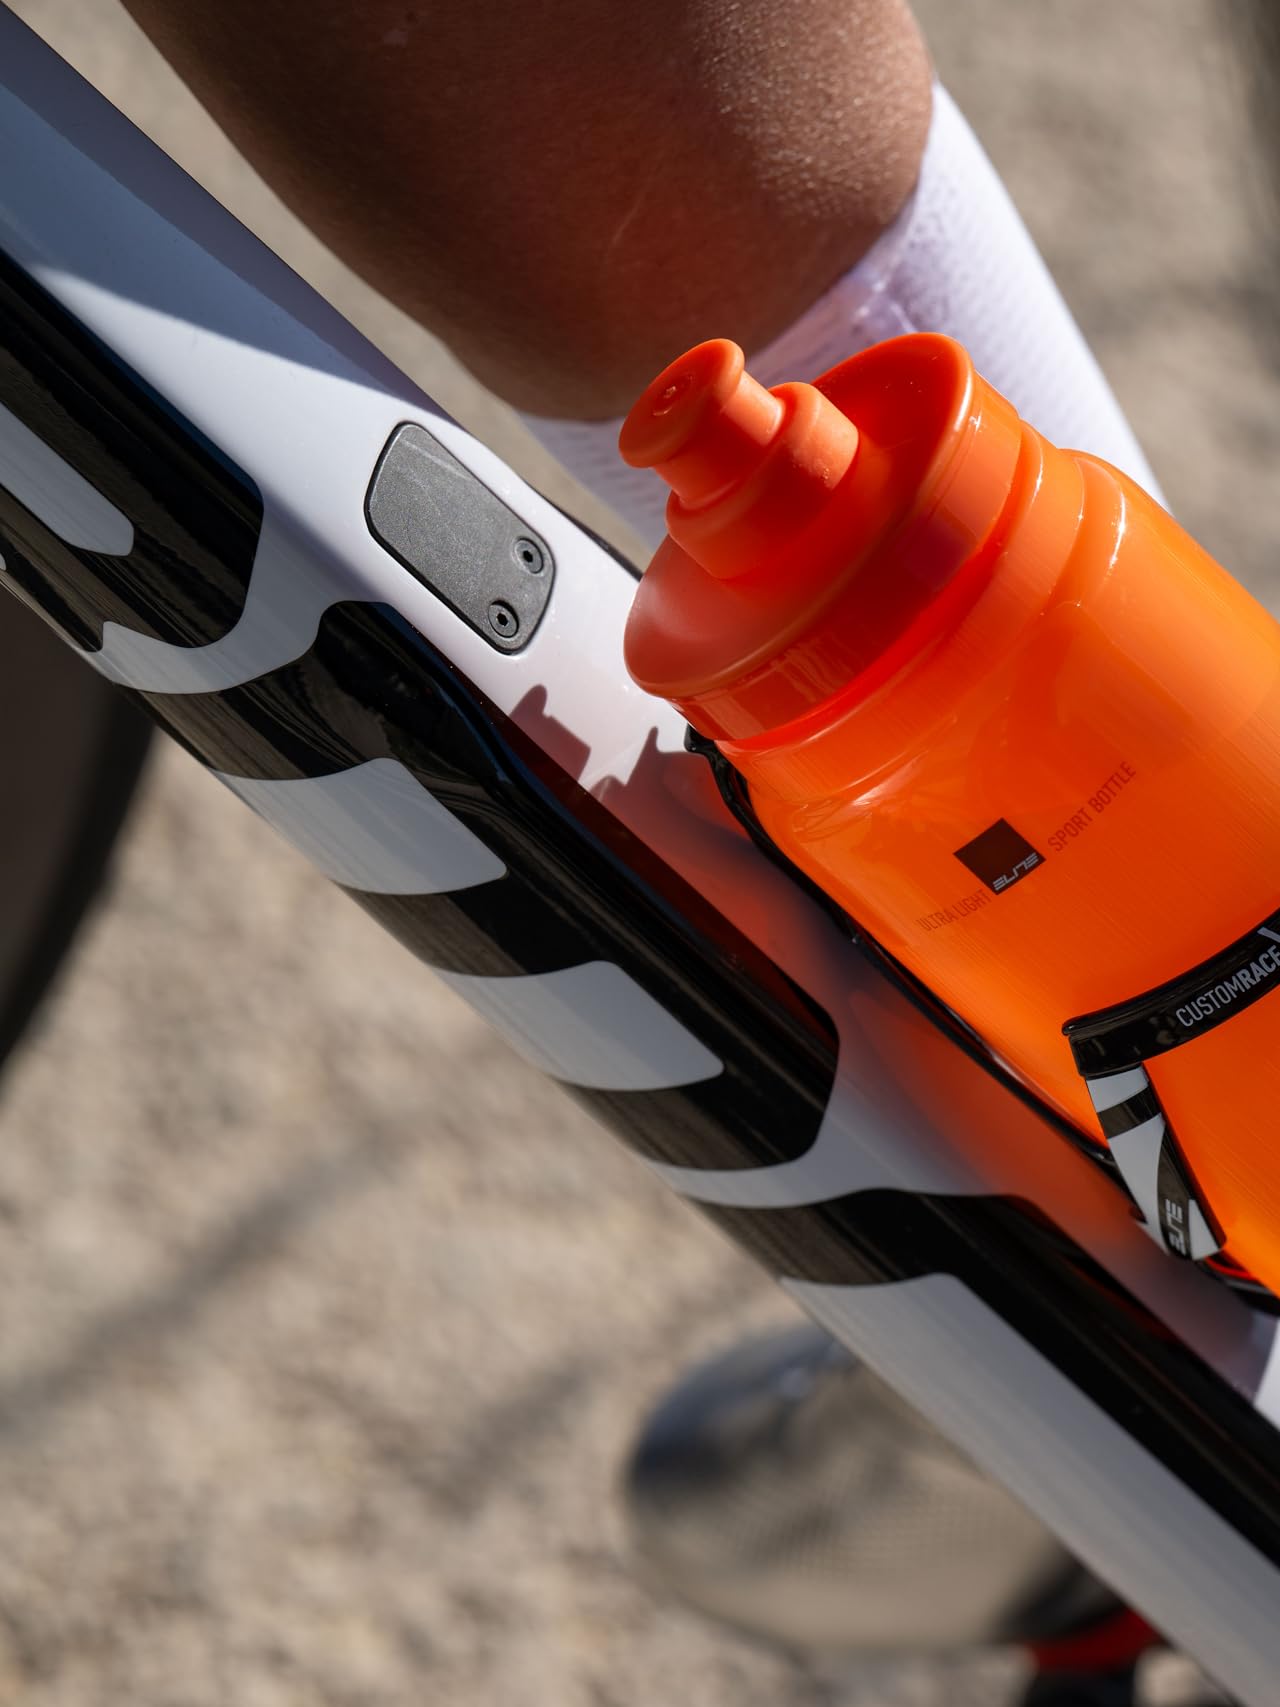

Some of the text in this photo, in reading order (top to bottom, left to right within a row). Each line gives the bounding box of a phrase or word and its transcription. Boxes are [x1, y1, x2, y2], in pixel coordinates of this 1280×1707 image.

[1047, 761, 1136, 852] SPORT BOTTLE
[992, 852, 1039, 891] ELITE
[914, 888, 992, 932] ULTRA LIGHT
